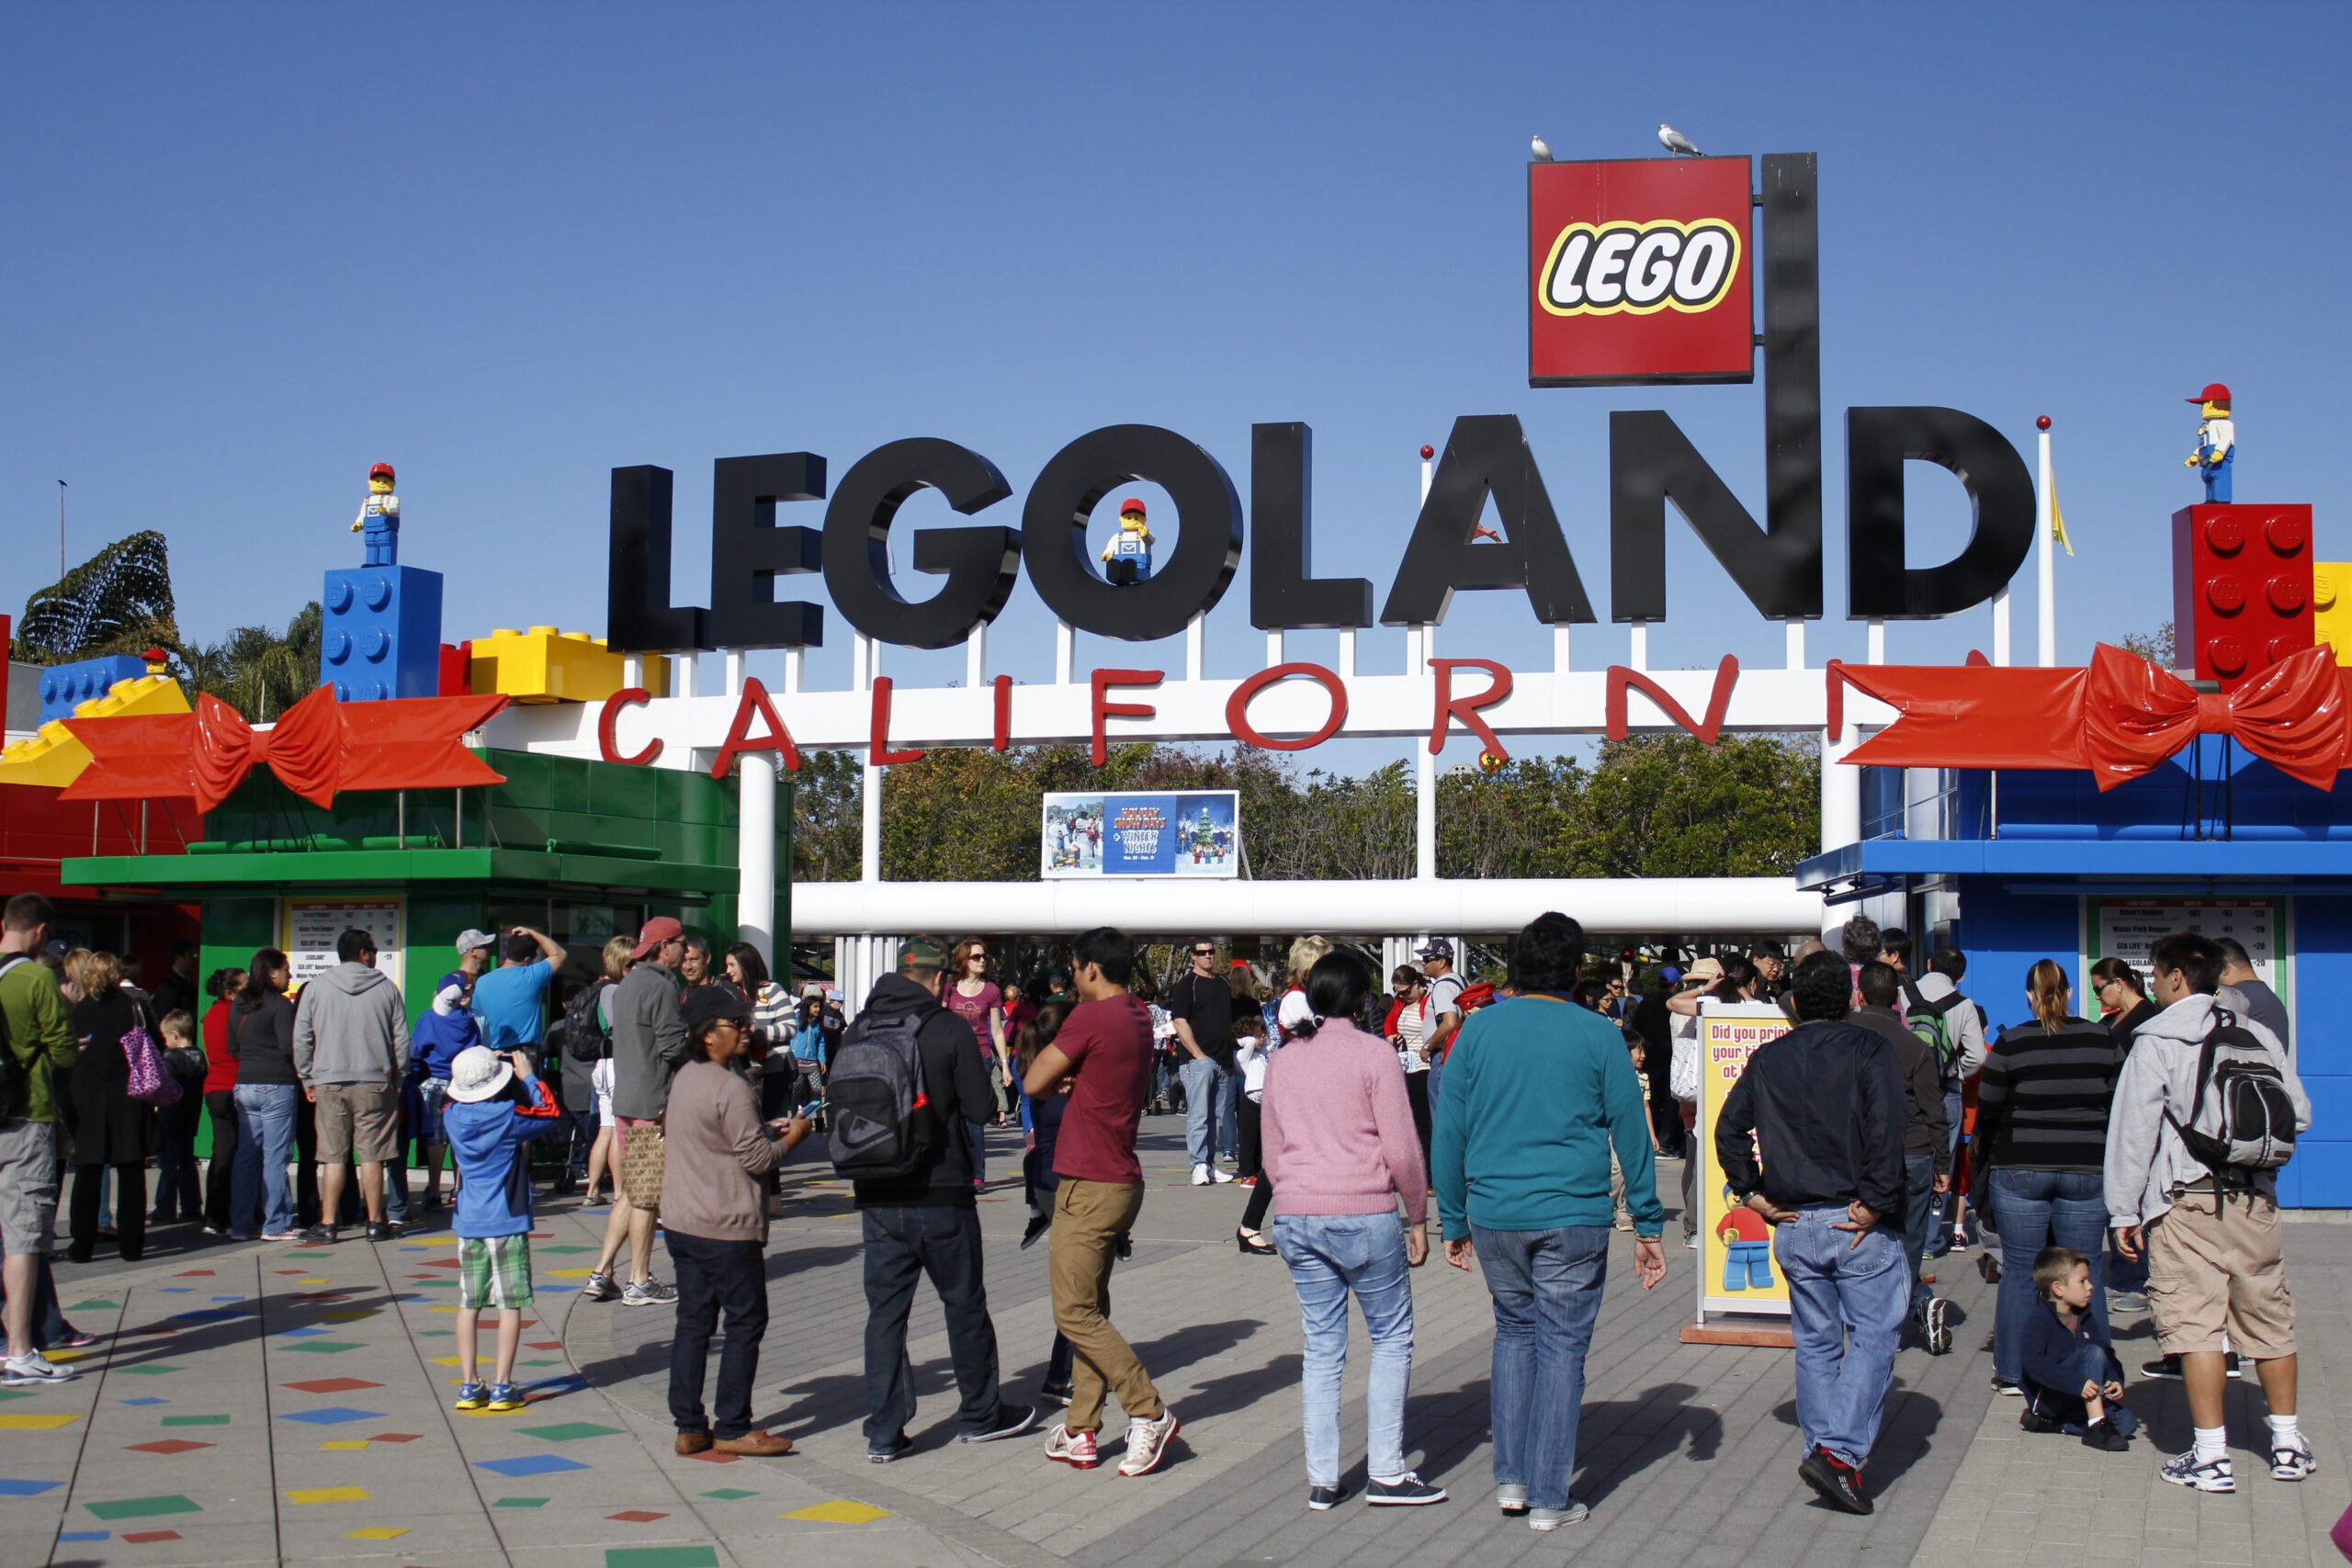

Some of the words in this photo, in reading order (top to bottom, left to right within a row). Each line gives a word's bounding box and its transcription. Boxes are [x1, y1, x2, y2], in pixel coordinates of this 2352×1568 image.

[1547, 227, 1735, 307] LEGO
[598, 649, 1991, 779] CALIFORNI
[1143, 818, 1166, 829] DAYS
[1121, 829, 1159, 842] WINTER
[1124, 841, 1158, 854] NIGHTS
[1712, 1024, 1731, 1039] Did
[1734, 1028, 1756, 1043] you
[1713, 1046, 1742, 1062] your
[1723, 1065, 1737, 1077] at
